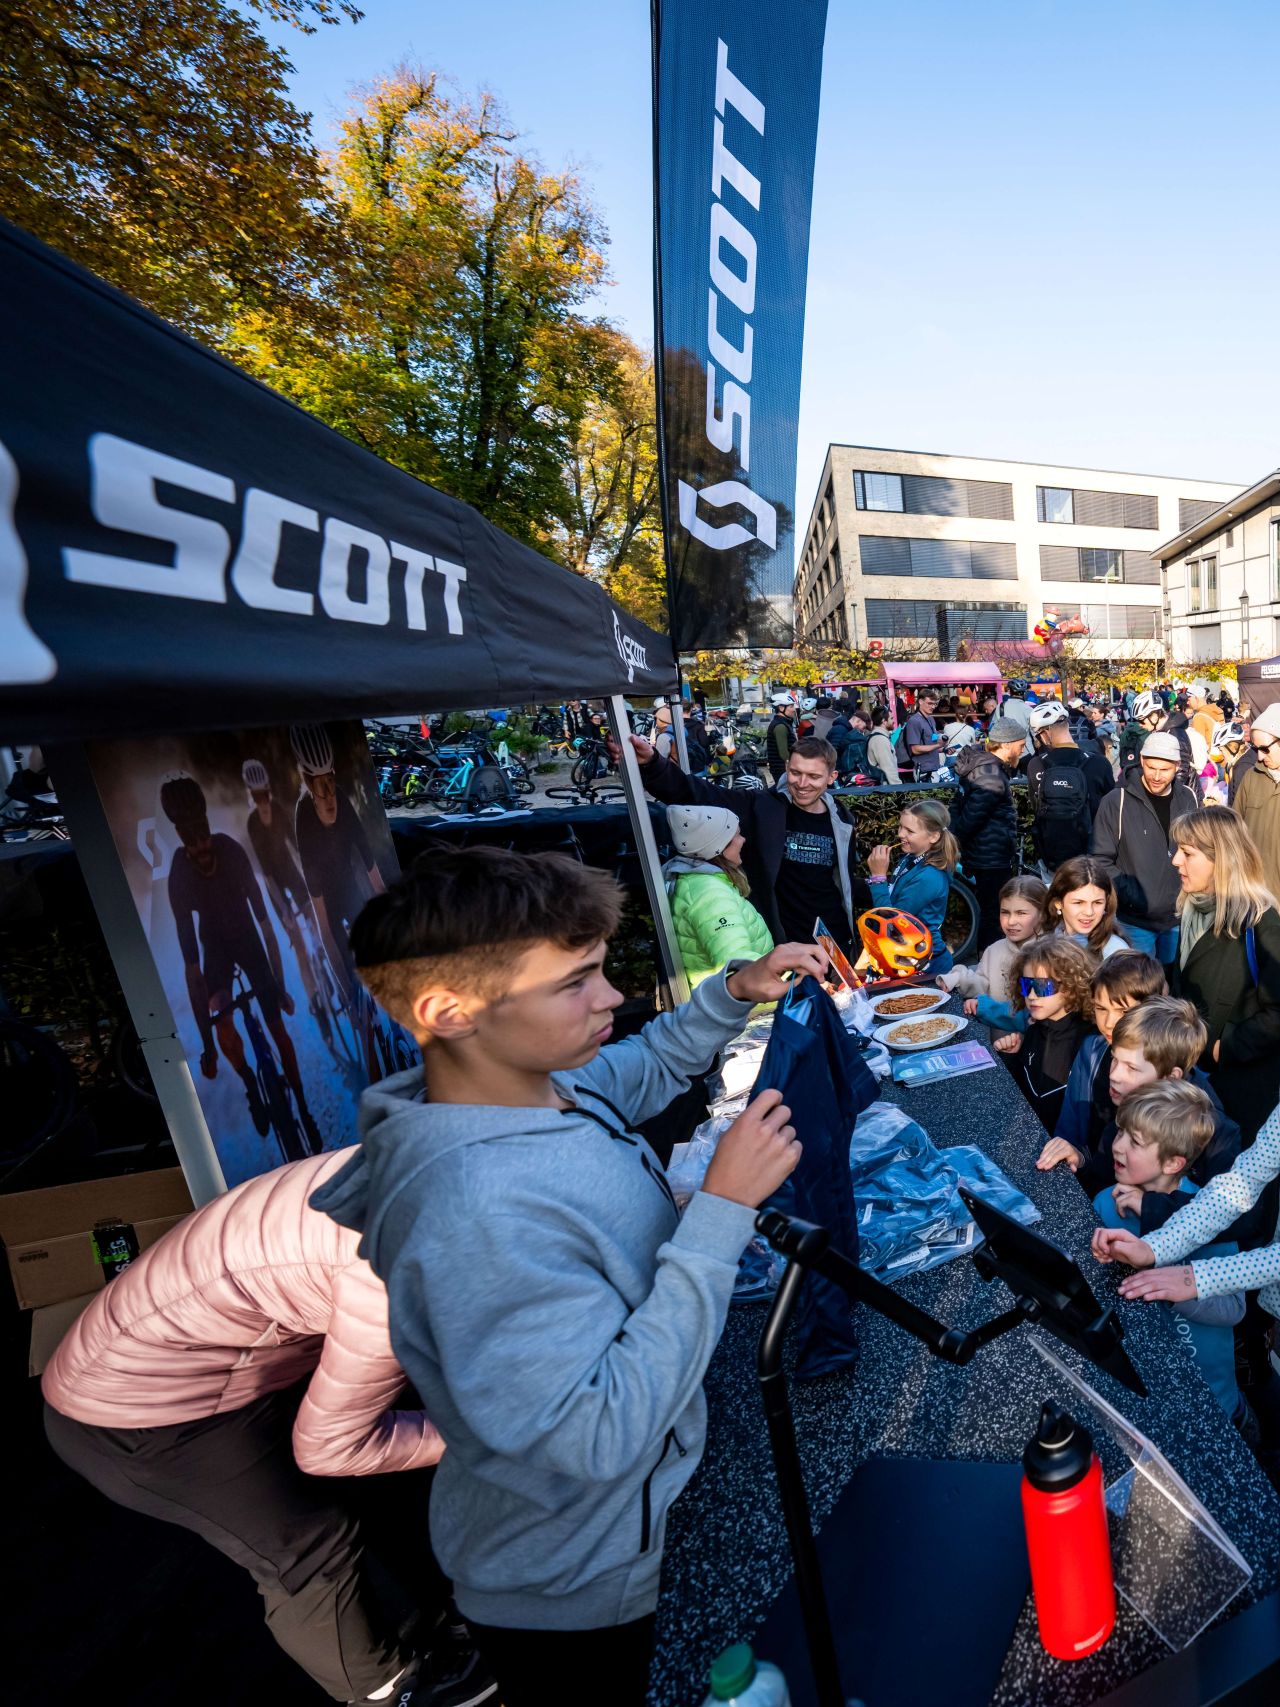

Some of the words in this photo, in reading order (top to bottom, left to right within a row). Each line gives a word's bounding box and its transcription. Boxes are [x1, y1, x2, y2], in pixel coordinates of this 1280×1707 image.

[705, 36, 766, 473] SCOTT
[61, 431, 469, 637] SCOTT
[622, 634, 652, 671] SCOTT
